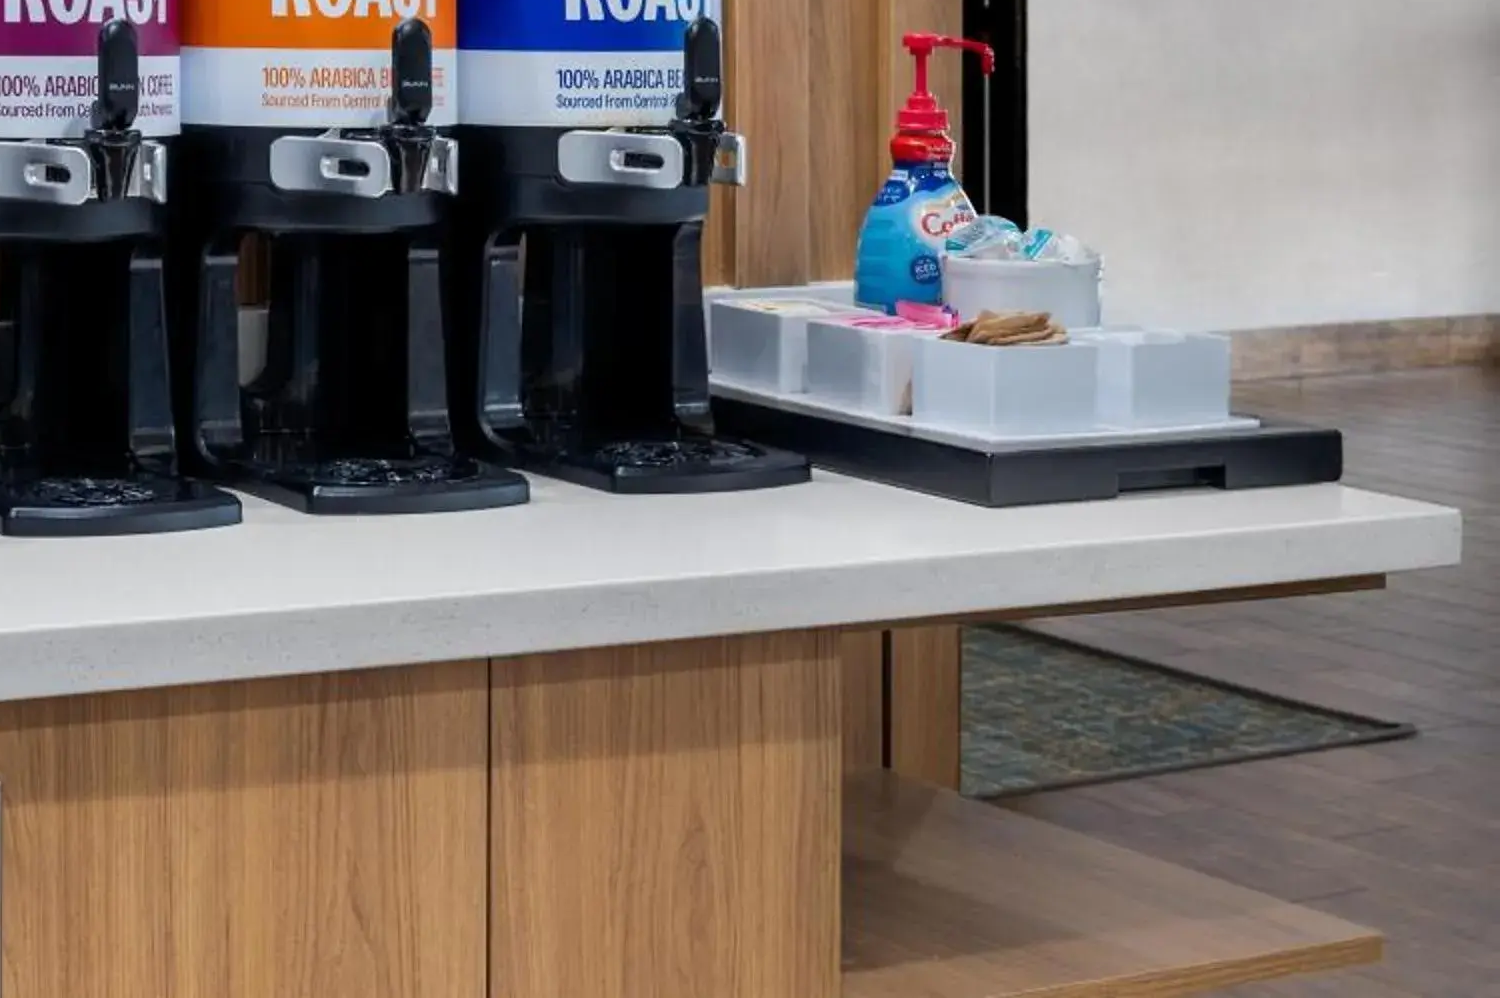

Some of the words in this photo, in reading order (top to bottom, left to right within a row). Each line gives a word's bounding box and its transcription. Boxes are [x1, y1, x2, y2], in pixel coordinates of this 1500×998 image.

[44, 75, 99, 98] ARABIC
[262, 66, 307, 89] 100%
[310, 66, 377, 89] ARABICA
[557, 69, 600, 90] 100%
[603, 69, 665, 90] ARABICA
[45, 102, 75, 118] From
[262, 93, 309, 108] Sourced
[312, 93, 342, 108] From
[556, 93, 601, 110] Sourced
[606, 93, 633, 109] From
